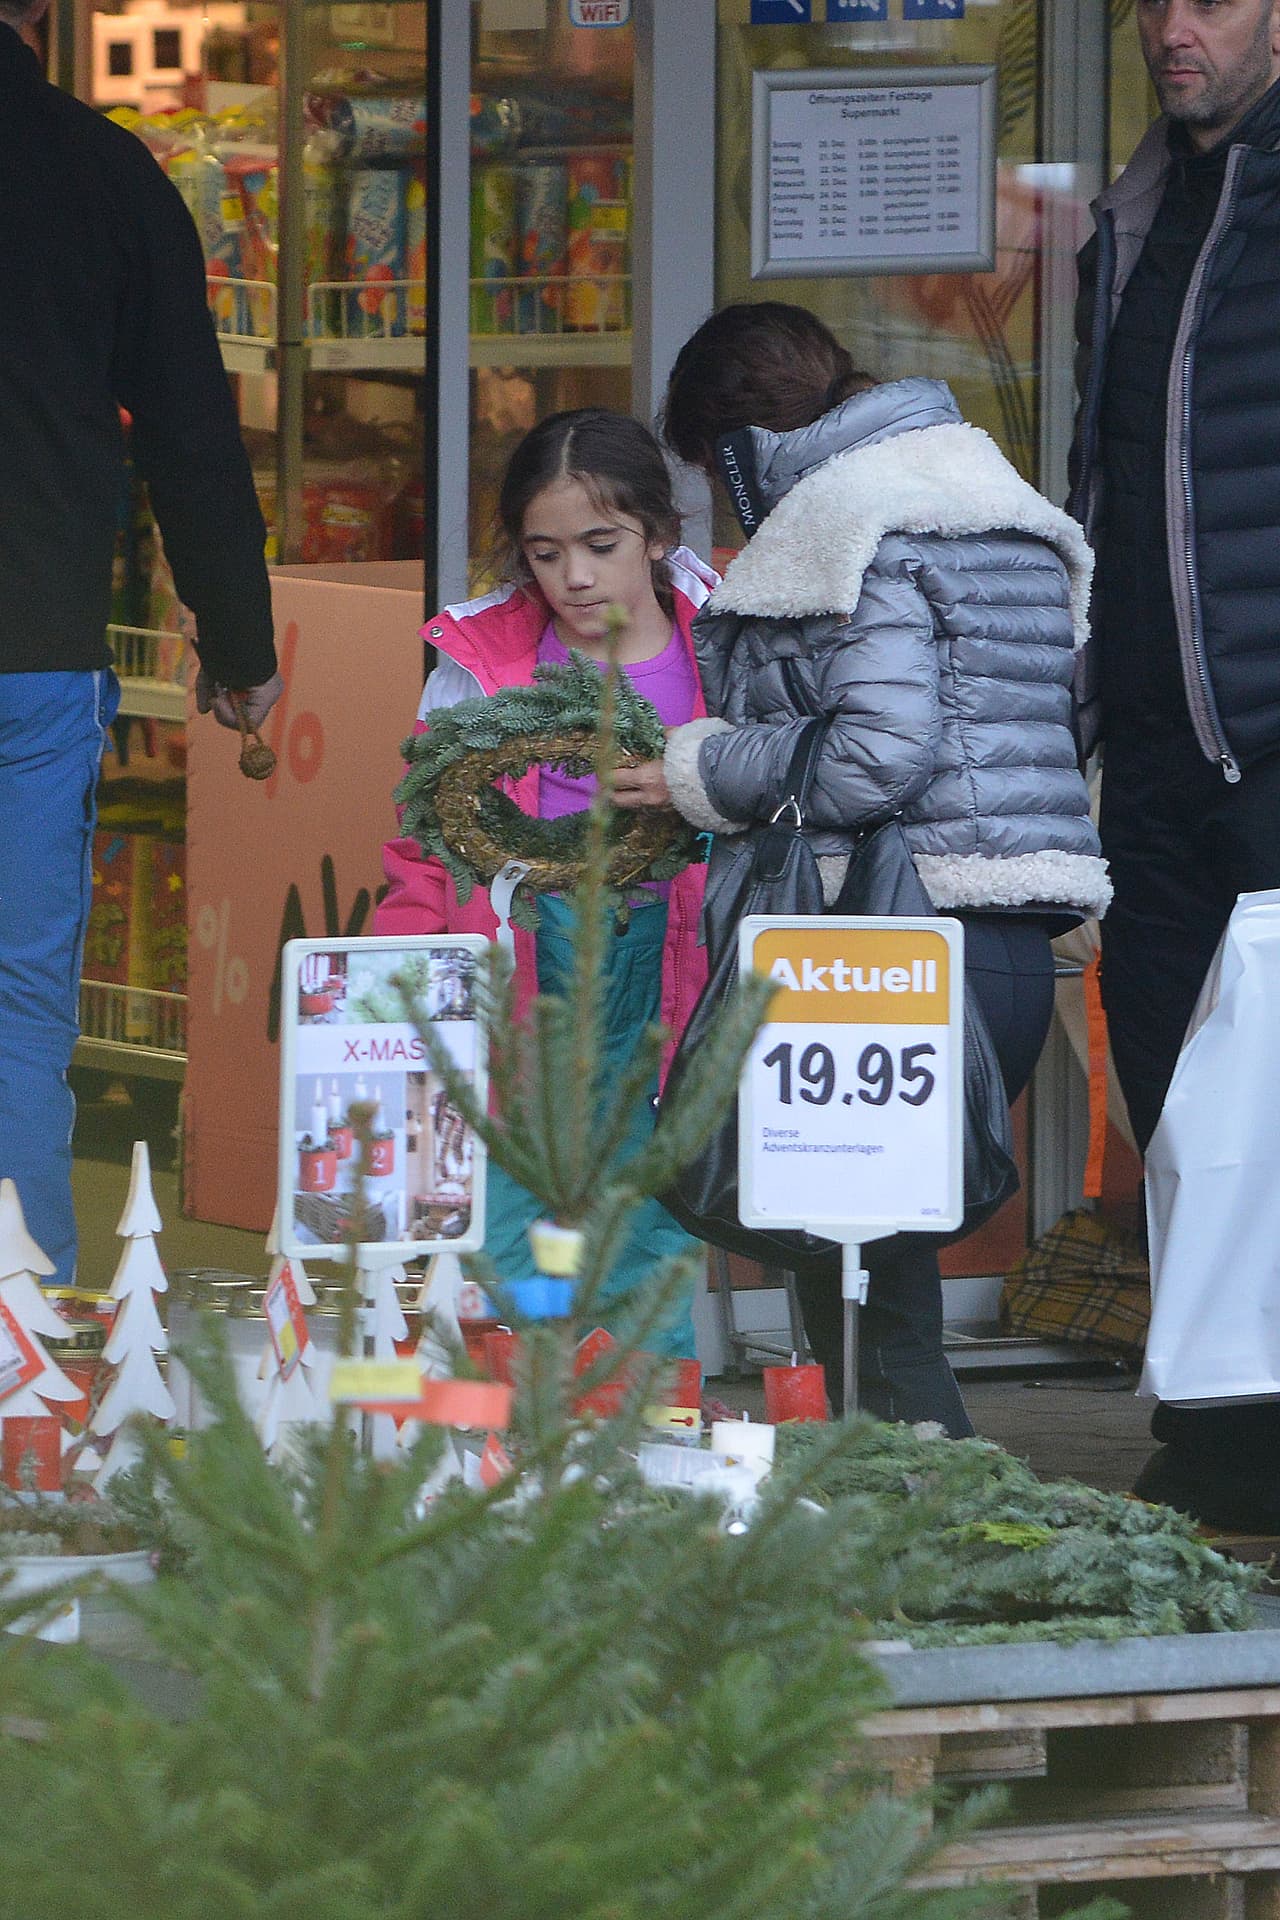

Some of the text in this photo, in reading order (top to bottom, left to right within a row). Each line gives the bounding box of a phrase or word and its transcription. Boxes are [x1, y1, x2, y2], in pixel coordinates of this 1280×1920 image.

[581, 4, 620, 21] WiFi
[840, 107, 900, 119] Supermarkt
[723, 444, 756, 526] MONCLER
[767, 957, 938, 993] Aktuell
[343, 1038, 426, 1062] X-MAS
[762, 1042, 937, 1106] 19.95
[762, 1127, 801, 1138] Diverse
[313, 1160, 326, 1184] 1
